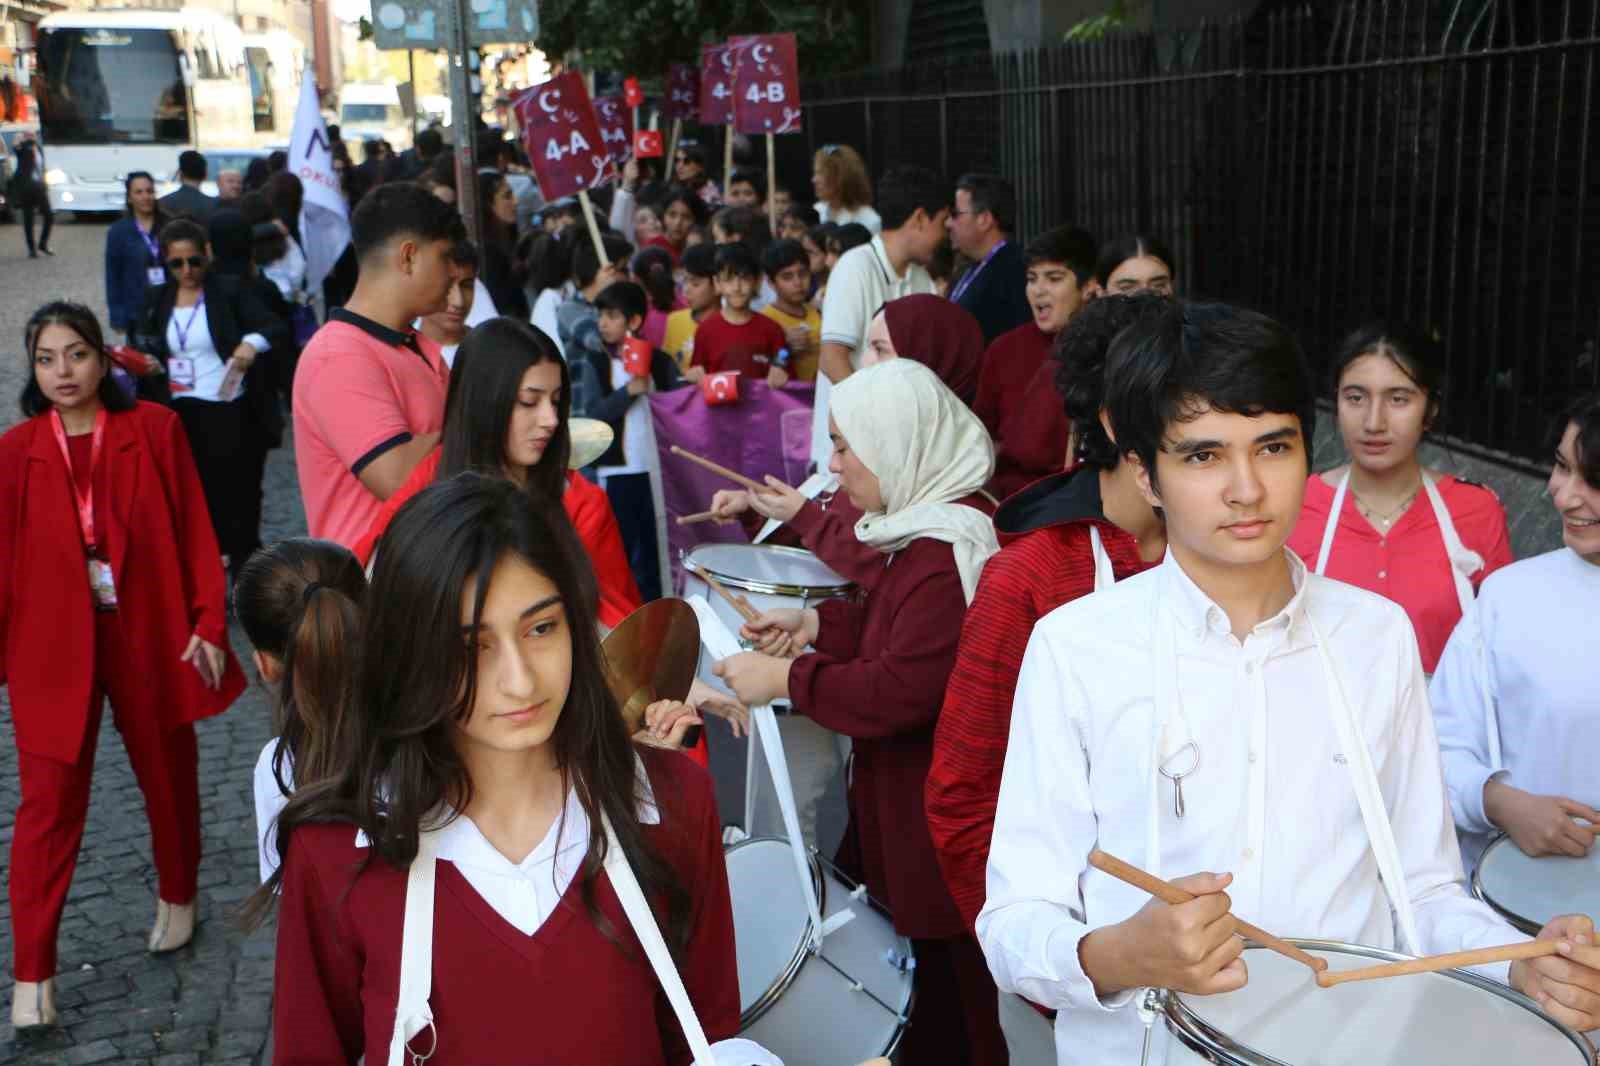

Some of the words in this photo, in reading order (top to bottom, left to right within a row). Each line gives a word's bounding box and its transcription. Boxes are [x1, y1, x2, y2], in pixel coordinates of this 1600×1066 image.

[712, 81, 733, 99] 4-
[745, 81, 785, 103] 4-B
[545, 130, 590, 161] 4-A
